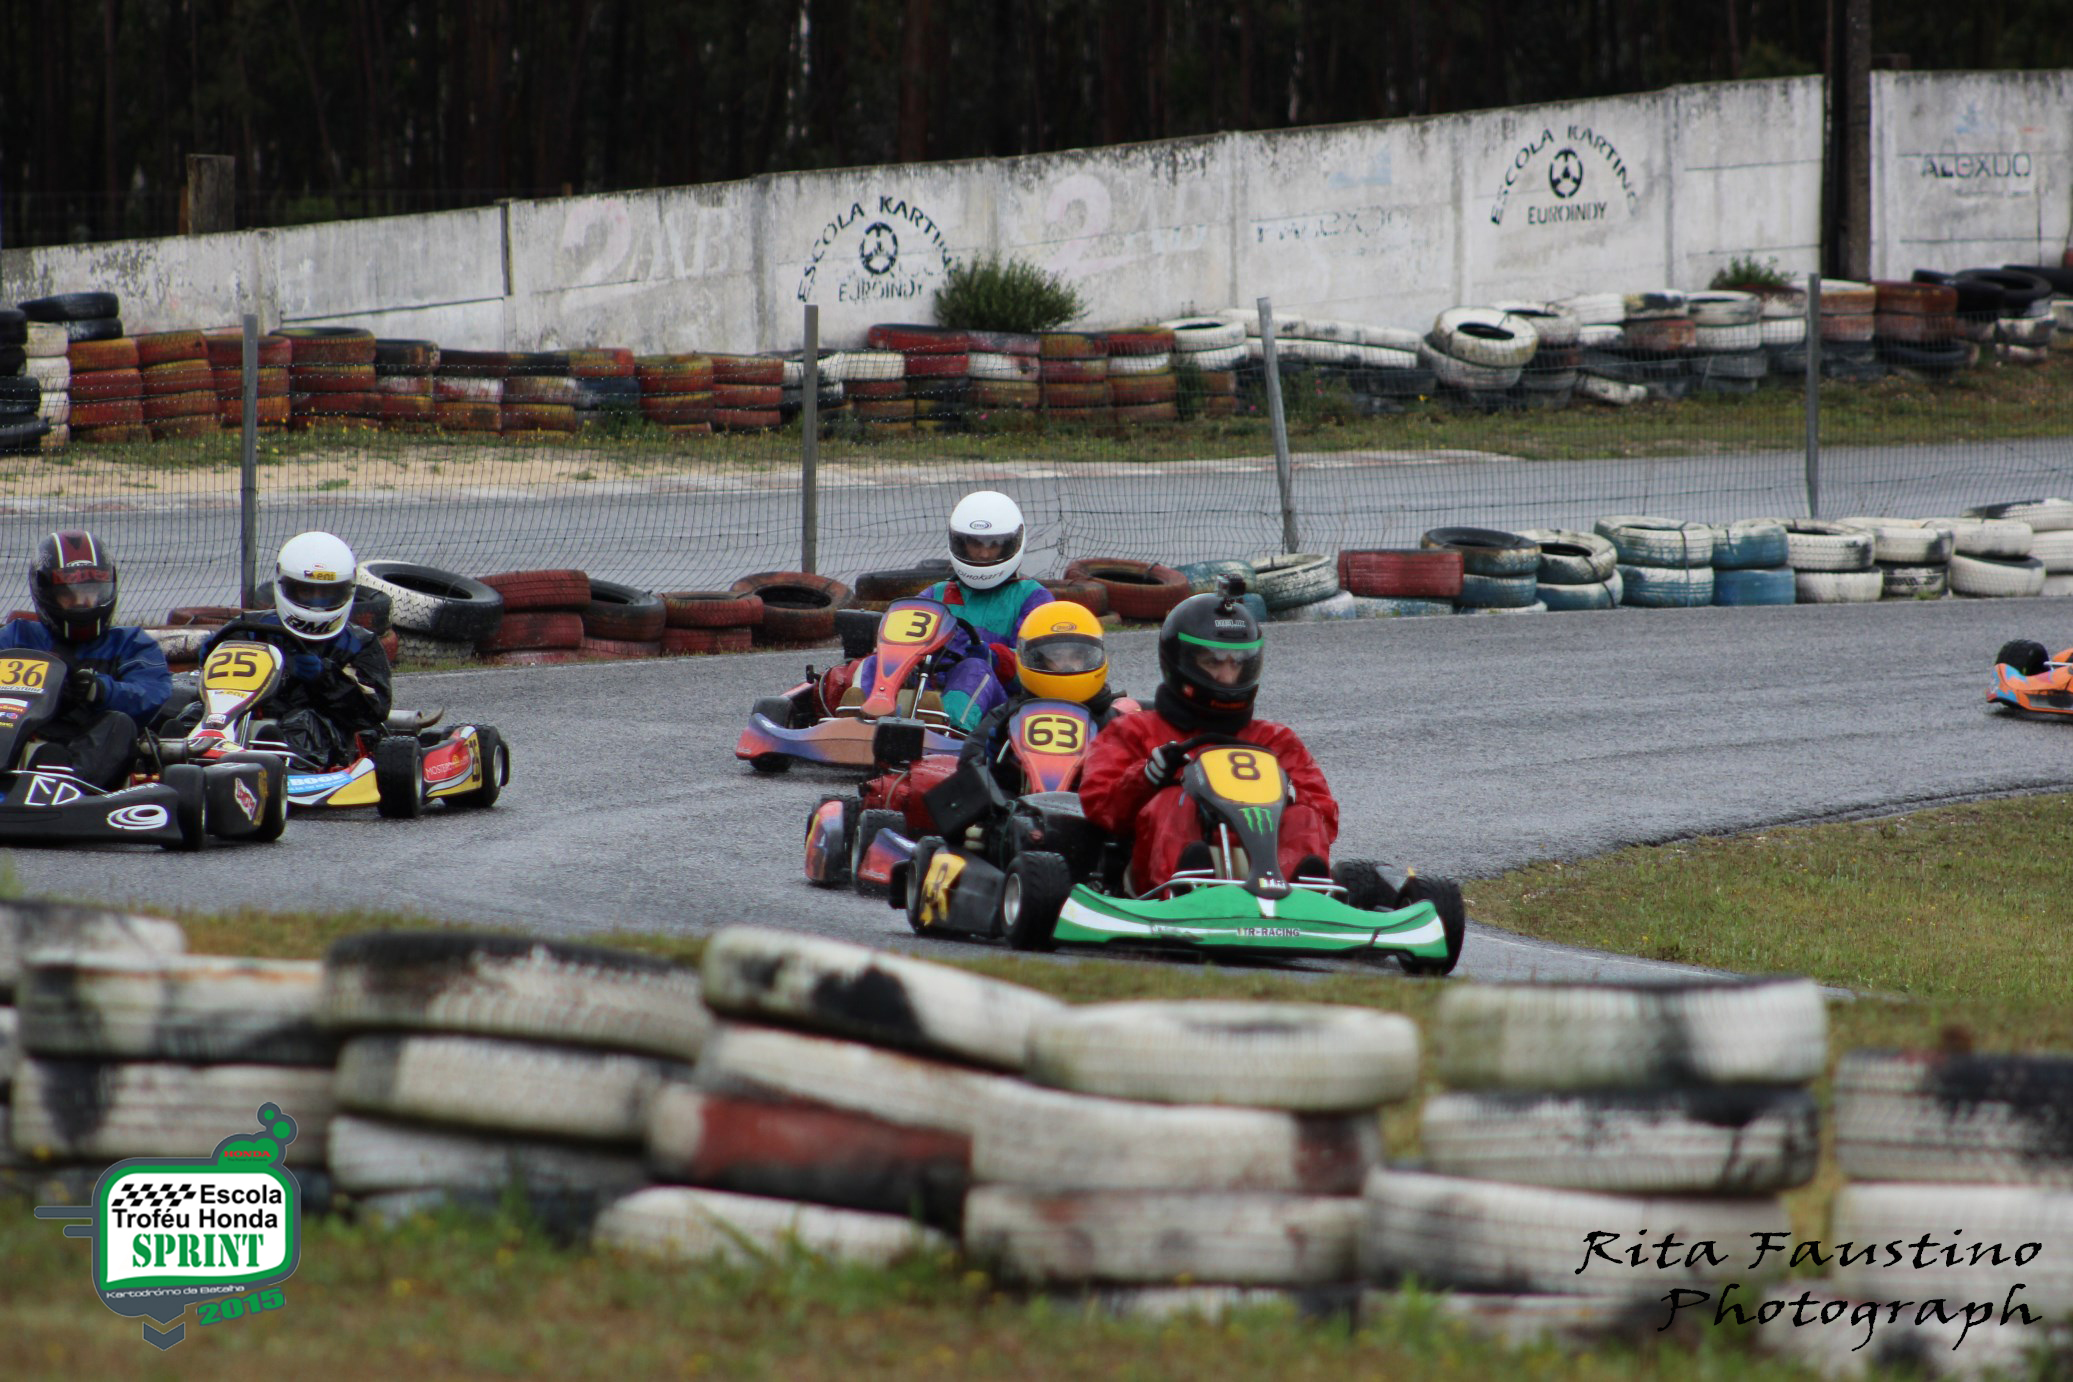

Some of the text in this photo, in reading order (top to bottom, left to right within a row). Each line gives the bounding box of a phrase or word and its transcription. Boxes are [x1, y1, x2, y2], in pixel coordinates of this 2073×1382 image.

[1490, 128, 1554, 226] ESCOLA
[1527, 202, 1608, 225] EUROINDY
[797, 202, 866, 303] ESCOLA
[905, 611, 932, 638] 3
[1, 660, 45, 687] 36
[207, 651, 258, 680] 25
[1027, 716, 1079, 749] 63
[1227, 751, 1261, 781] 8
